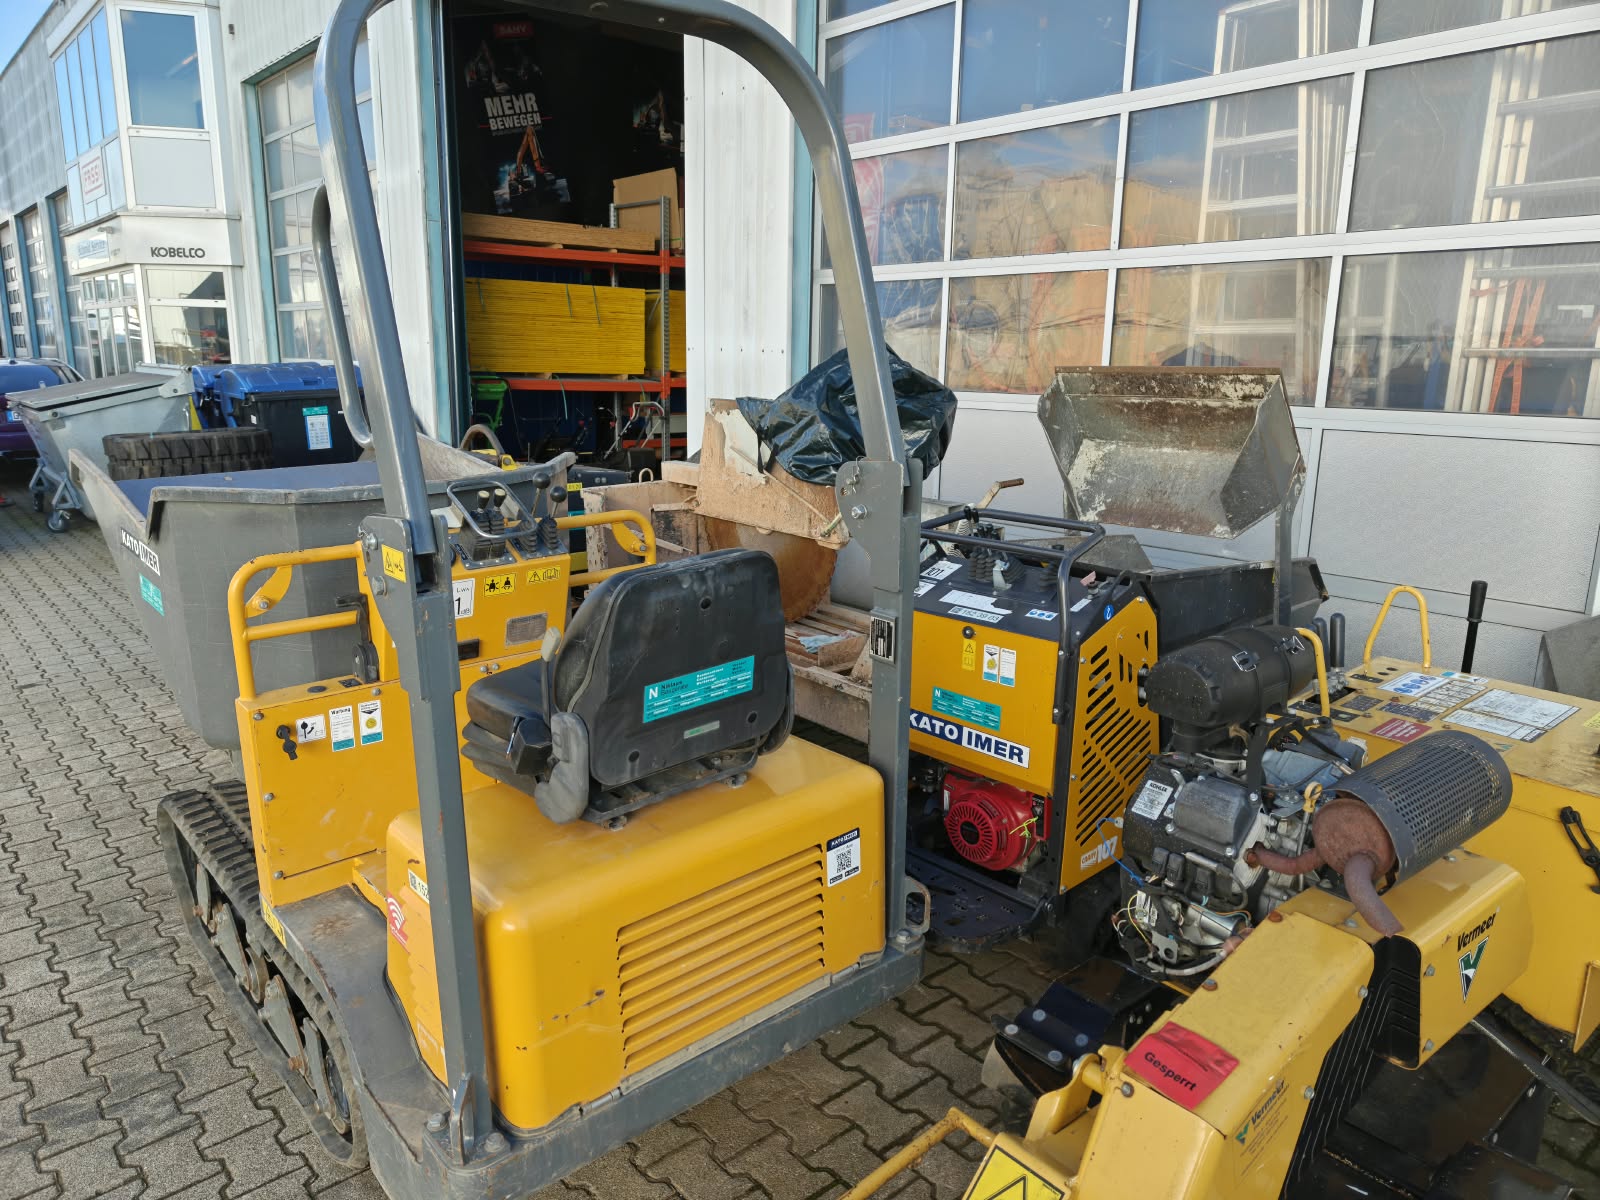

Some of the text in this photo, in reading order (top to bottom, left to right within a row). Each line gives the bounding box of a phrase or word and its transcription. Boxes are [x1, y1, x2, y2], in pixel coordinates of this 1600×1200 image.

[484, 92, 539, 119] MEHR
[489, 112, 542, 132] BEWEGEN
[150, 246, 206, 259] KOBELCO
[121, 529, 140, 555] KATO
[649, 686, 659, 700] N
[967, 731, 1025, 764] IMER
[1457, 913, 1496, 951] Vermeer
[1144, 1050, 1198, 1092] Gesperrt
